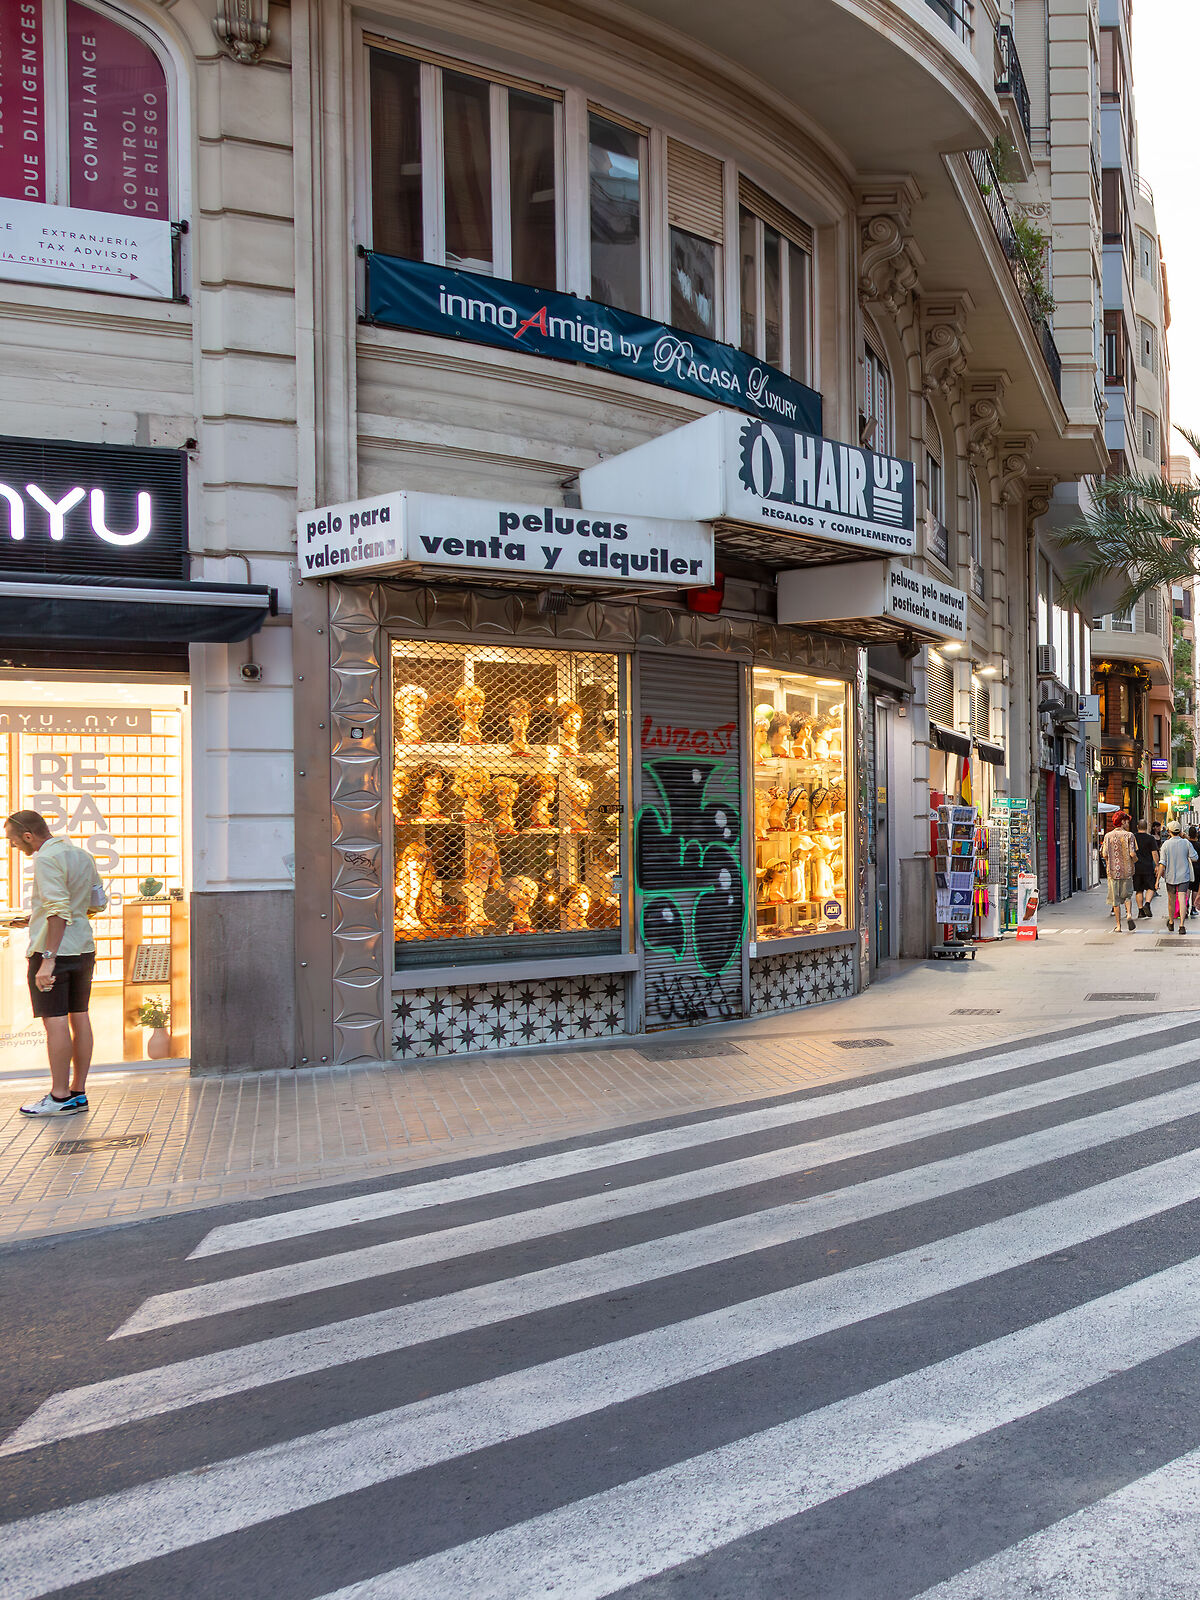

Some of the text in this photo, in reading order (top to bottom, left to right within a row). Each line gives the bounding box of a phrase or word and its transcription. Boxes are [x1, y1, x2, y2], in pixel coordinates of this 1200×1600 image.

[21, 3, 39, 198] DUE DILIGENCES
[82, 35, 98, 182] COMPLIANCE
[122, 107, 137, 210] CONTROL
[143, 93, 159, 212] DE RIESGO
[38, 241, 138, 261] TAX ADVISOR
[42, 228, 138, 247] EXTRANJERÍA
[21, 255, 75, 268] CRISTINA
[91, 264, 111, 273] PTA
[619, 333, 643, 364] by
[795, 433, 904, 519] HAIR UP
[306, 505, 391, 541] pelo para
[498, 508, 628, 540] pelucas
[761, 506, 814, 527] REGALOS
[818, 519, 828, 529] Y
[830, 520, 912, 547] COMPLEMENTOS
[305, 537, 396, 569] valenciana
[420, 534, 703, 577] venta y alquiler
[891, 570, 964, 612] pelucas pelo natural
[892, 594, 930, 620] posticeria
[938, 611, 963, 632] medida
[32, 752, 106, 791] RE
[1101, 756, 1114, 766] UB
[827, 906, 839, 915] ADT
